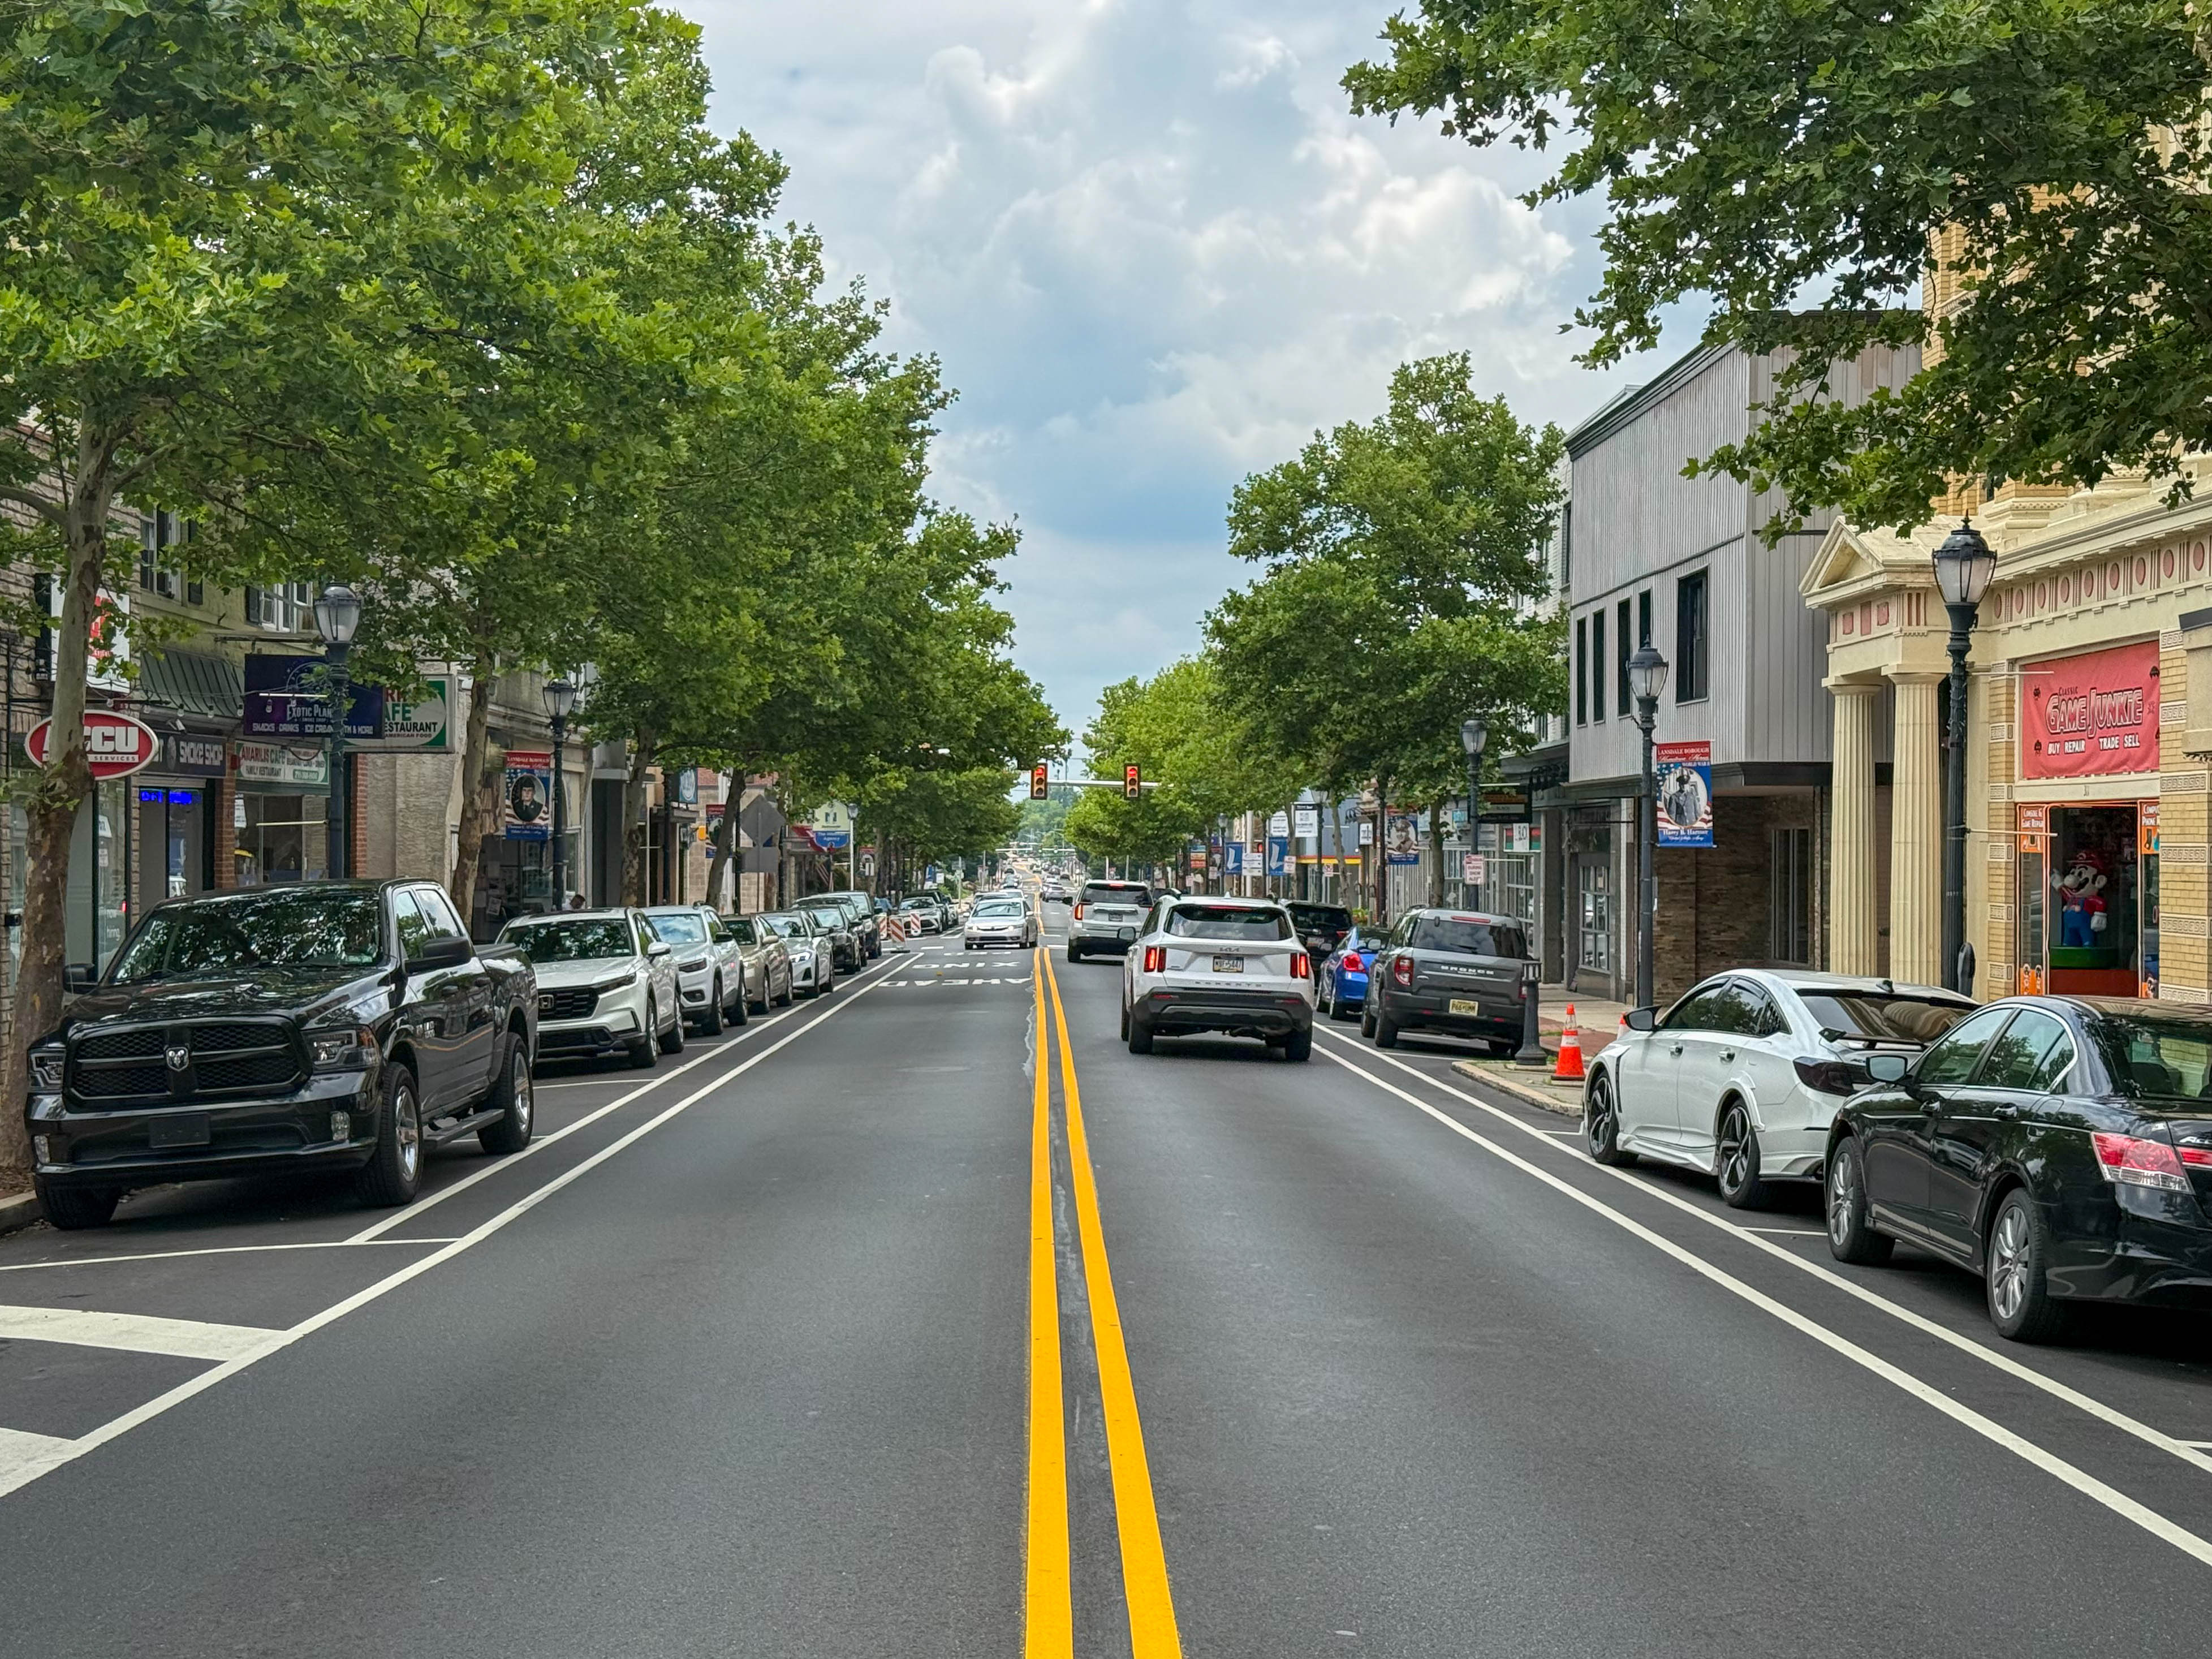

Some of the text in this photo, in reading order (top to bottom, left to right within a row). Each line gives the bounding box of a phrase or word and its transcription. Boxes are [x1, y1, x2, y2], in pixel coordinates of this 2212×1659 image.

[2059, 686, 2078, 696] CLASSIC
[287, 704, 333, 721] EXOTIC PLAN
[385, 703, 412, 721] AFE
[2046, 687, 2144, 739] GAME JUNKIE
[252, 723, 275, 732] SNACKS
[279, 723, 299, 732] DRINKS
[305, 725, 314, 733] ICE
[315, 725, 333, 733] CREA
[358, 726, 373, 734] MORE
[385, 722, 438, 732] ESTAURANT
[2047, 733, 2141, 755] BUY REPAIR TRADE SELL
[205, 743, 223, 766] SHOP
[270, 748, 286, 764] CAFE
[258, 766, 282, 777] RESTAURANT
[877, 977, 1032, 986] AHEAD
